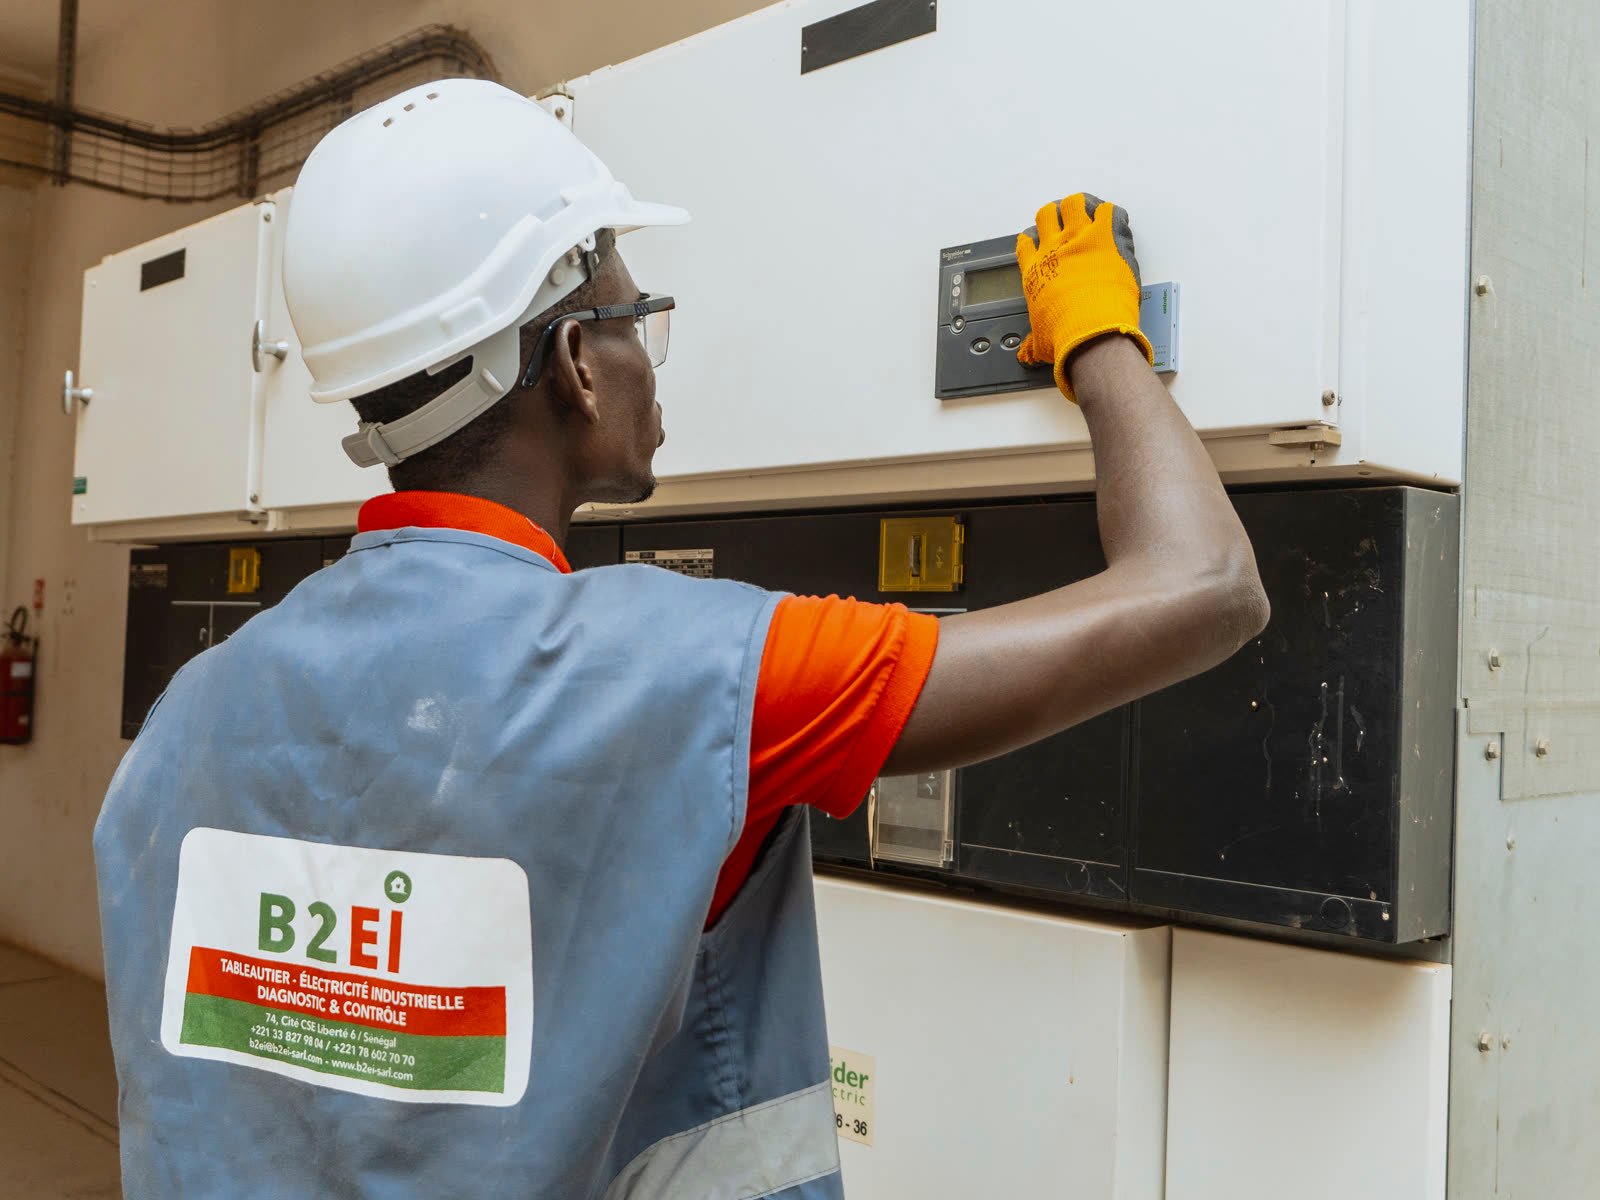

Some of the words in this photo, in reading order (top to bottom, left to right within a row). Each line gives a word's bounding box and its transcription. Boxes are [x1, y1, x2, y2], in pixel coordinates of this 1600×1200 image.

[221, 958, 291, 985] TABLEAUTIER
[300, 970, 369, 999] ÉLECTRICITÉ
[371, 986, 465, 1010] INDUSTRIELLE
[257, 985, 326, 1012] DIAGNOSTIC
[329, 998, 340, 1014] &
[343, 1001, 407, 1026] CONTRÔLE
[265, 1012, 279, 1026] 74,
[281, 1015, 299, 1028] Cité
[300, 1019, 316, 1032] CSE
[317, 1023, 348, 1038] Liberté
[350, 1029, 357, 1040] 6
[249, 1038, 323, 1065] b2ei@b2ei-sarl.com
[331, 1058, 414, 1081] www.b2ei-sarl.com
[251, 1025, 270, 1037] +221
[272, 1029, 283, 1040] 33
[285, 1031, 302, 1043] 827
[303, 1035, 313, 1046] 98
[314, 1038, 324, 1049] 04
[333, 1042, 356, 1055] +221
[358, 1046, 369, 1057] 78
[371, 1049, 387, 1062] 602
[389, 1052, 400, 1064] 70
[402, 1055, 415, 1066] 70
[853, 1119, 867, 1136] 36
